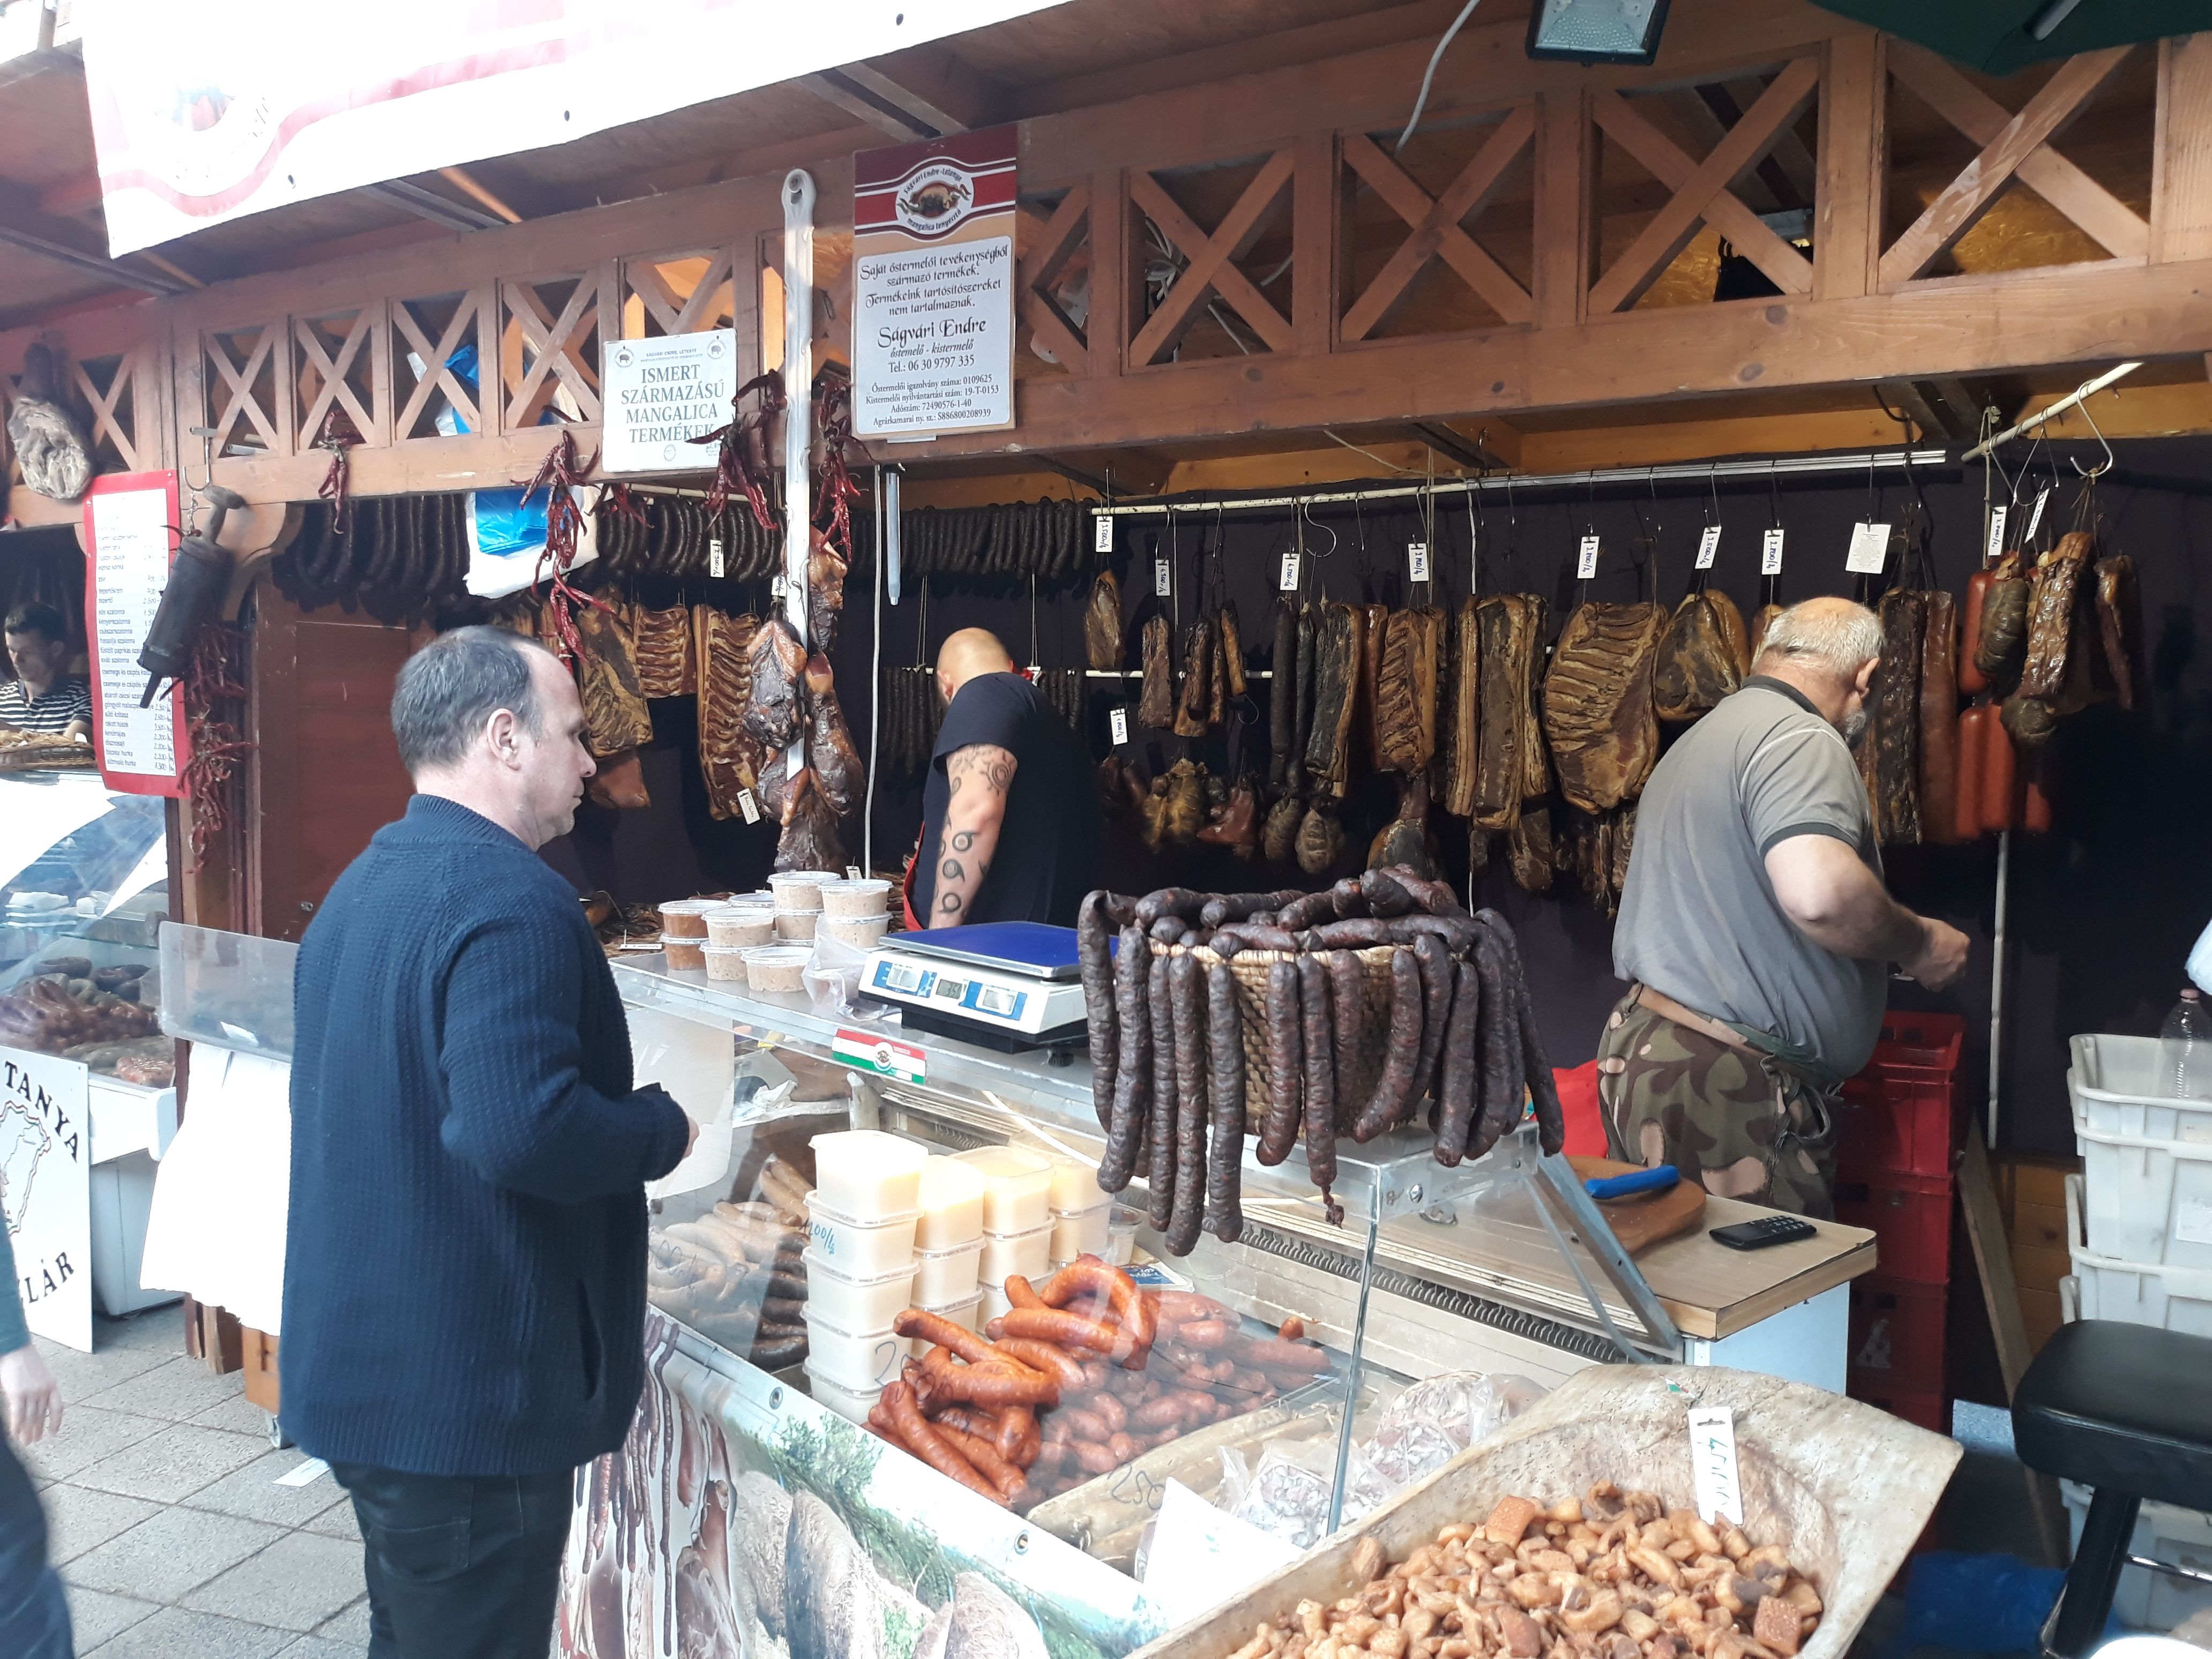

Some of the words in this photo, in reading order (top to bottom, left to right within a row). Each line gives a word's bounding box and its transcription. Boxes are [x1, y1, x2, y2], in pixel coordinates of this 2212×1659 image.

[889, 306, 908, 316] nem
[878, 322, 935, 348] Ságvári
[939, 317, 987, 337] Endre
[641, 364, 700, 384] ISMERT
[888, 362, 906, 373] Tel.:
[908, 360, 919, 371] 06
[921, 359, 932, 371] 30
[934, 356, 955, 370] 9797
[958, 354, 975, 367] 335
[621, 379, 724, 405] SZÁRMAZÁSÚ
[626, 403, 718, 424] MANGALICA
[4, 1060, 78, 1164] TANYA
[18, 1251, 74, 1304] LÁR
